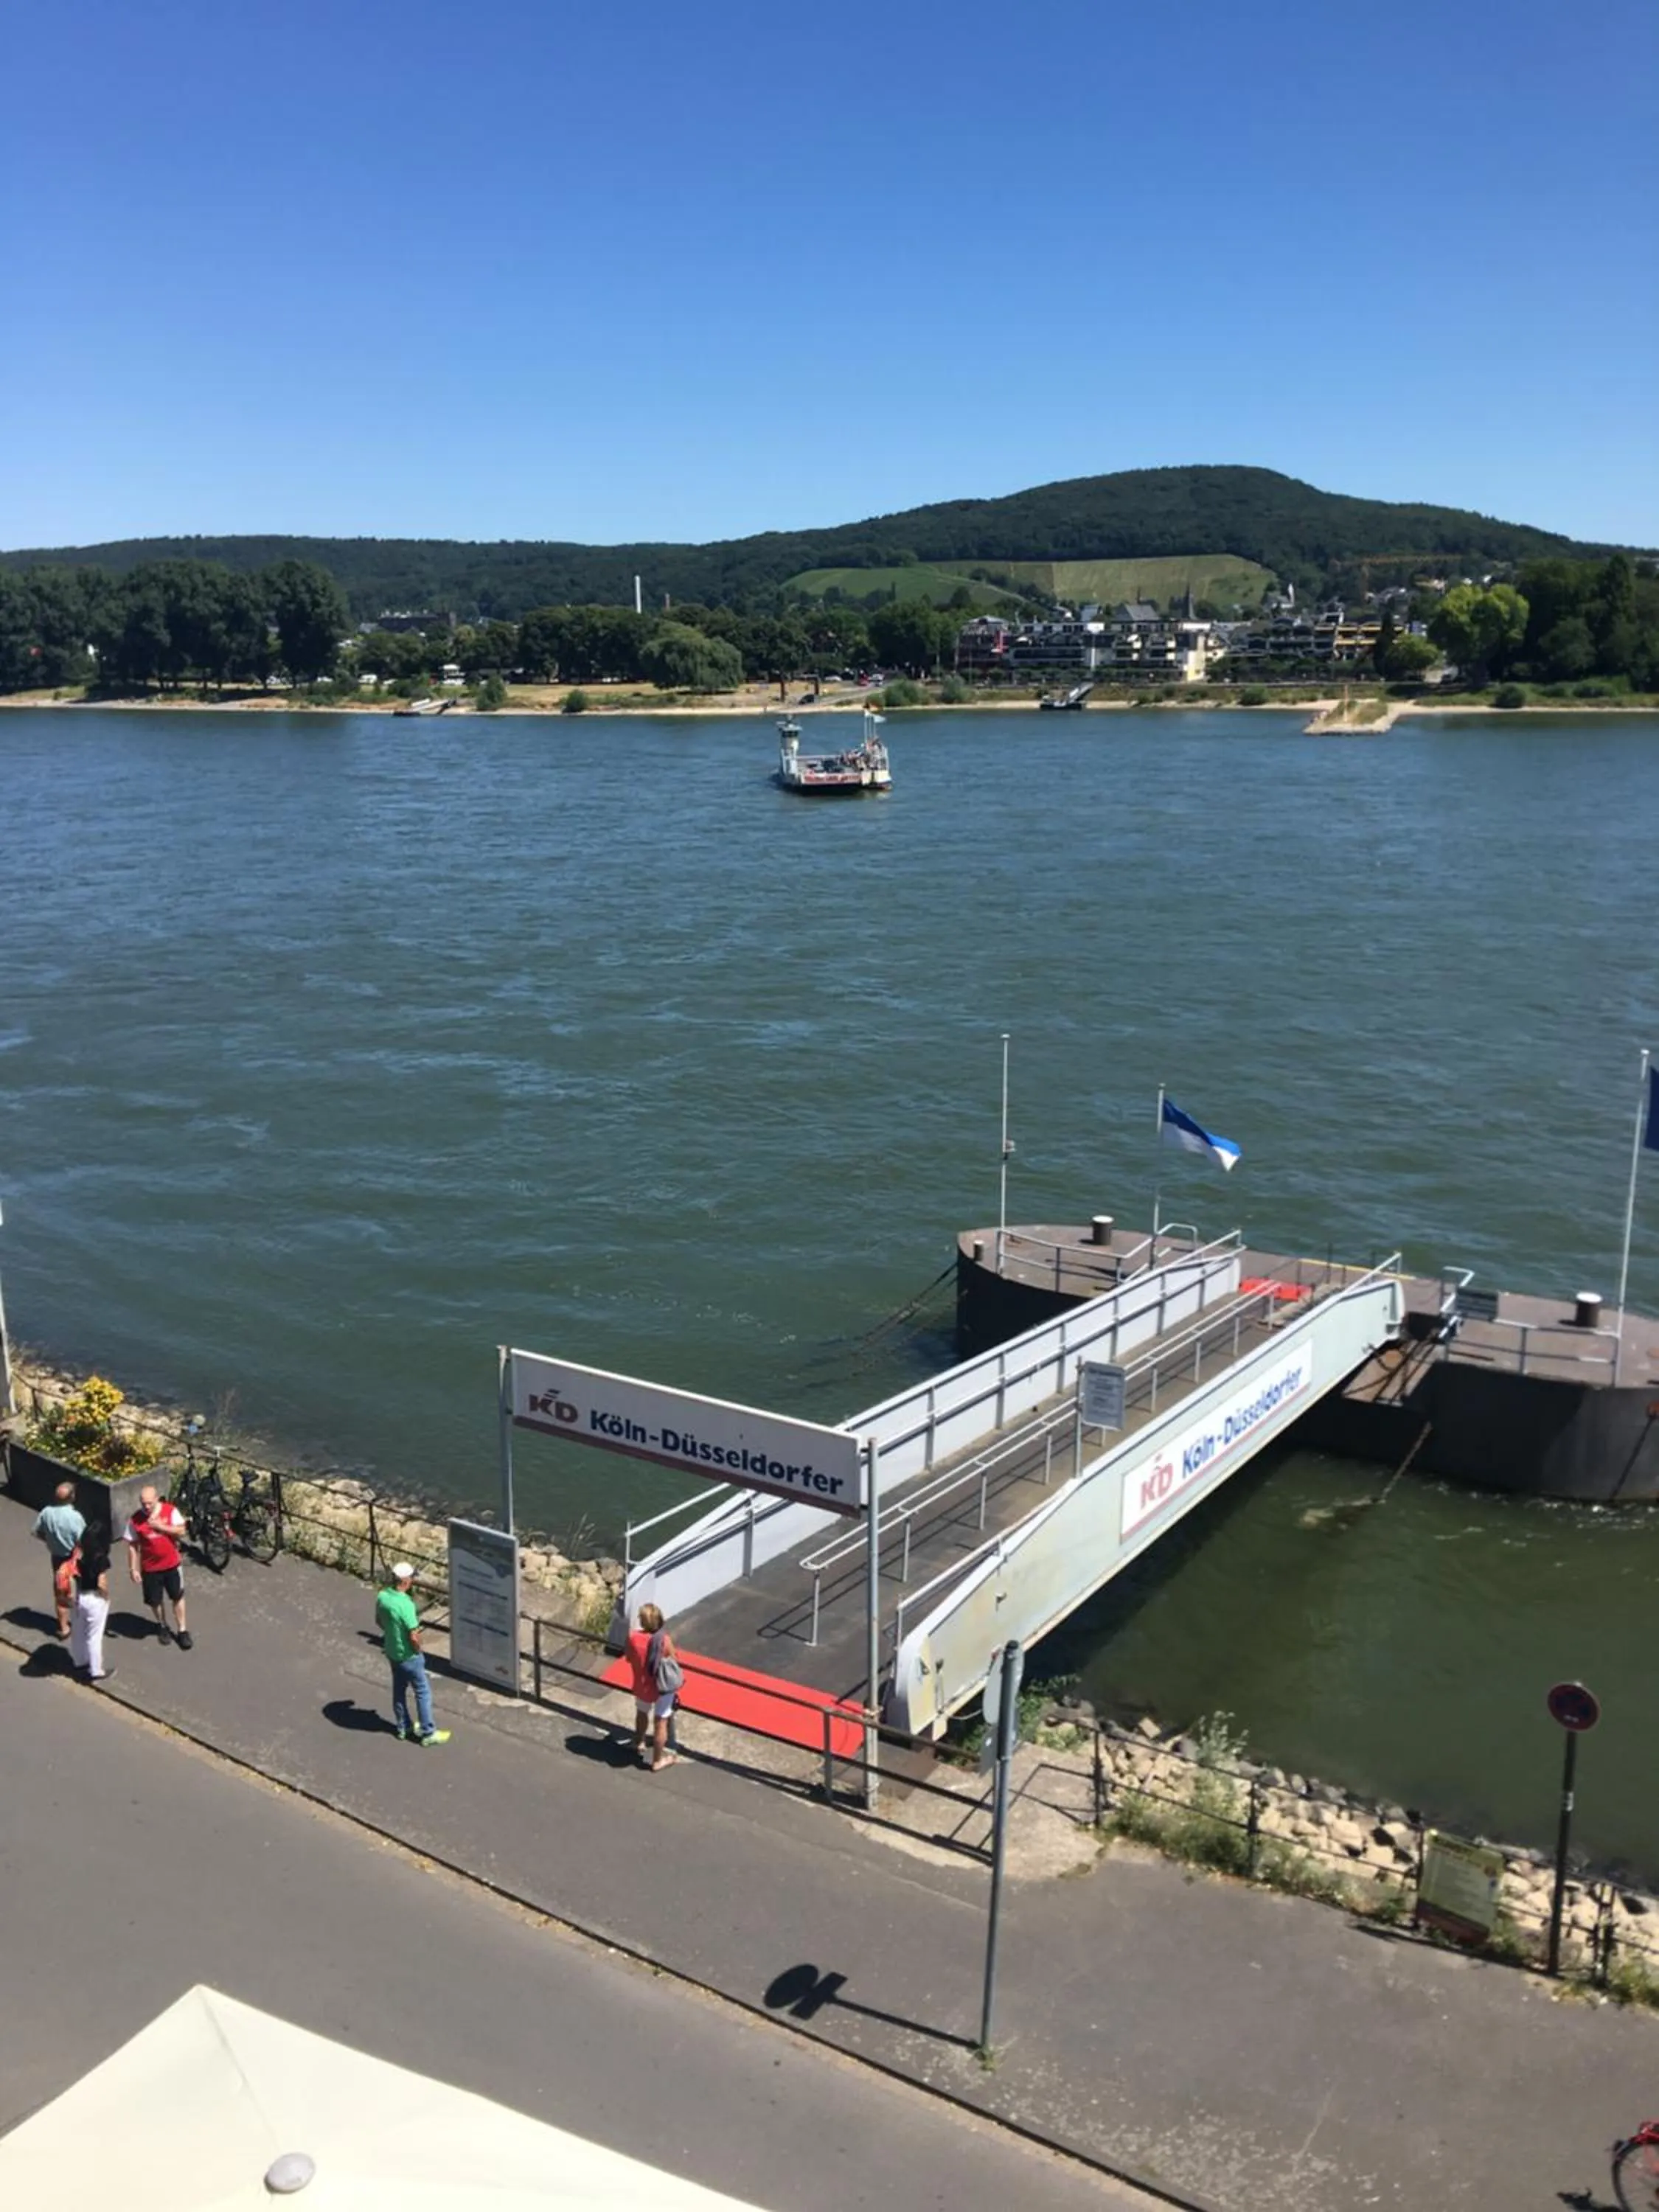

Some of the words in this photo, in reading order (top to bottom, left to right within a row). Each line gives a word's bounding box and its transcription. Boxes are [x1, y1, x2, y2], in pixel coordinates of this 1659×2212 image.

[528, 1390, 578, 1424] KD
[590, 1409, 844, 1495] Köln-Düsseldorfer
[1140, 1457, 1174, 1510] KD
